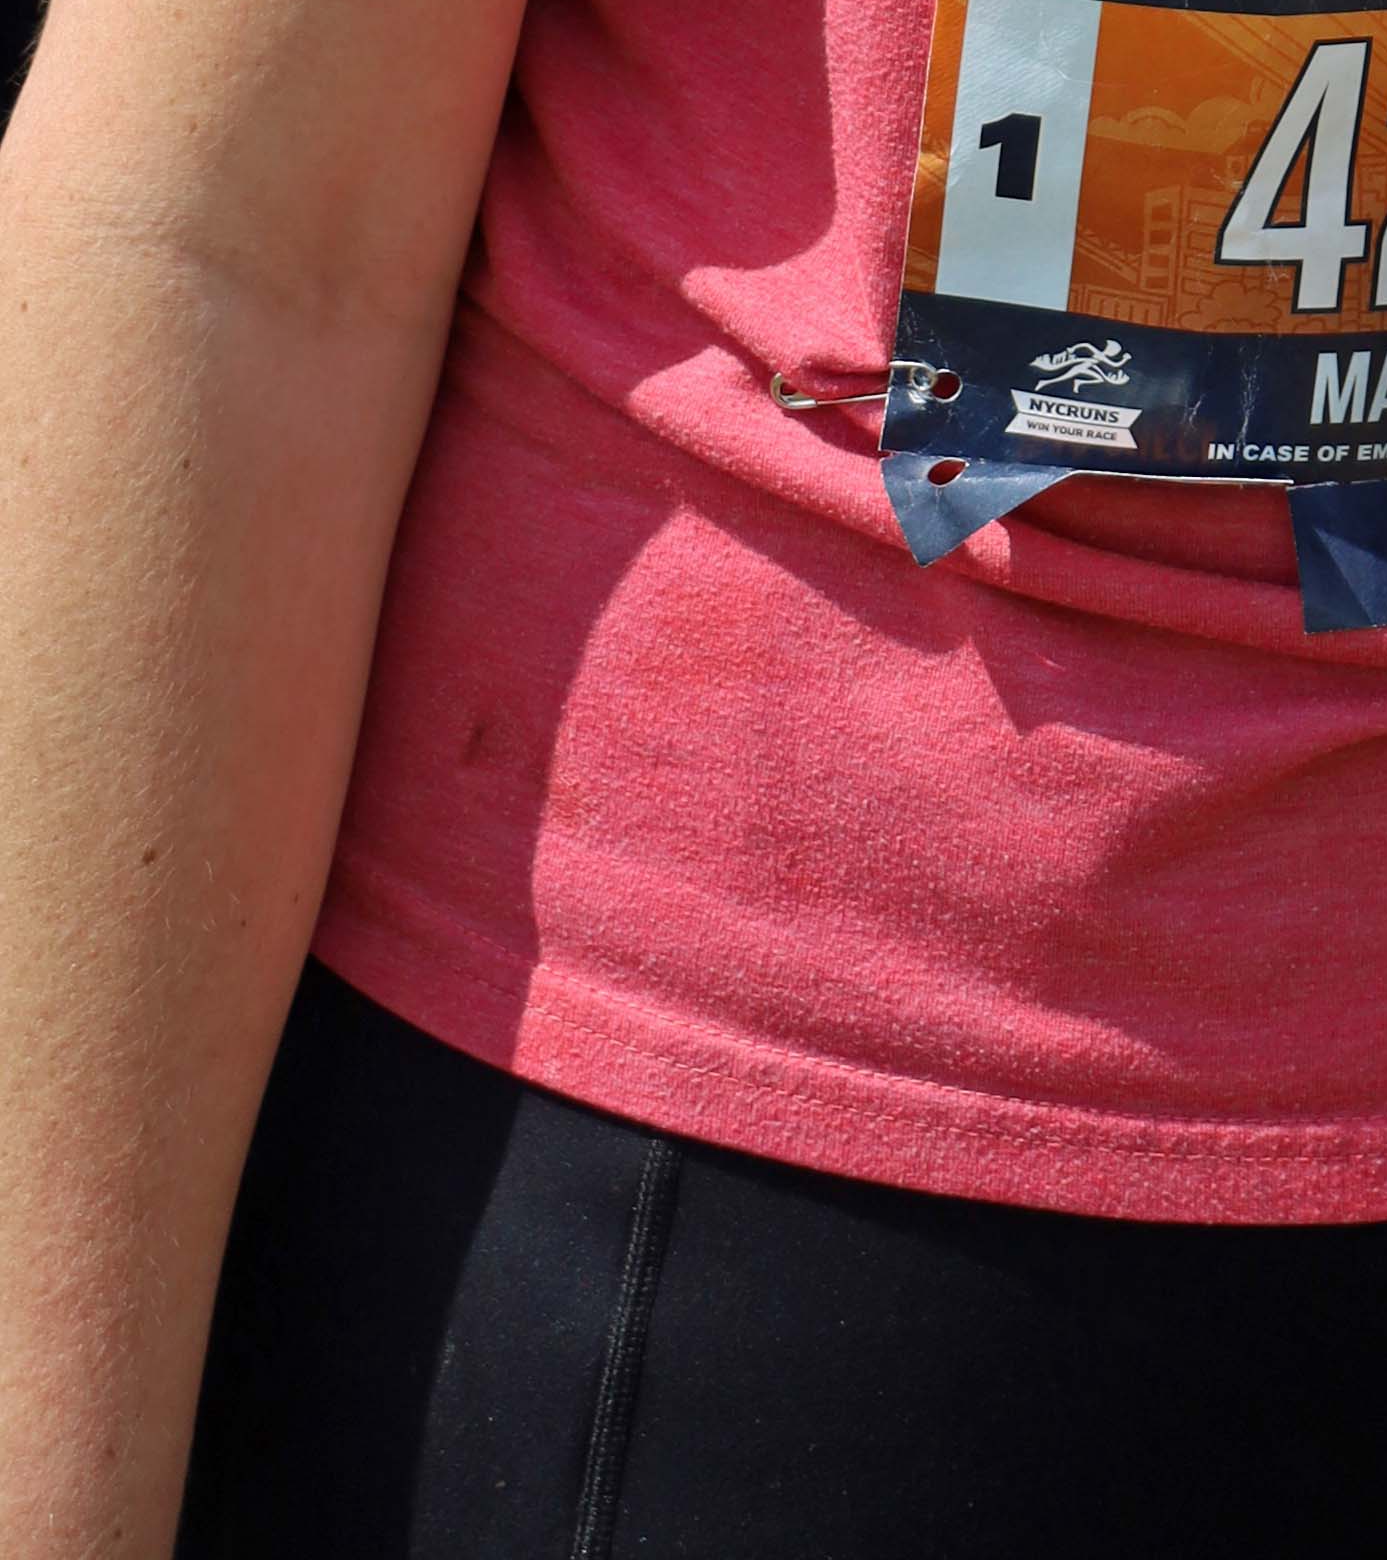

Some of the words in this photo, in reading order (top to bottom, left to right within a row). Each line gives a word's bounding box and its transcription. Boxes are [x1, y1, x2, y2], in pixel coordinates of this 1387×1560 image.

[978, 113, 1042, 201] 1
[1027, 396, 1121, 425] NYCRUNS
[1026, 420, 1051, 434] WIN
[1052, 424, 1085, 438] YOUR
[1085, 428, 1119, 442] RACE
[1207, 442, 1235, 461] IN
[1242, 442, 1309, 463] CASE
[1316, 444, 1348, 462] OF
